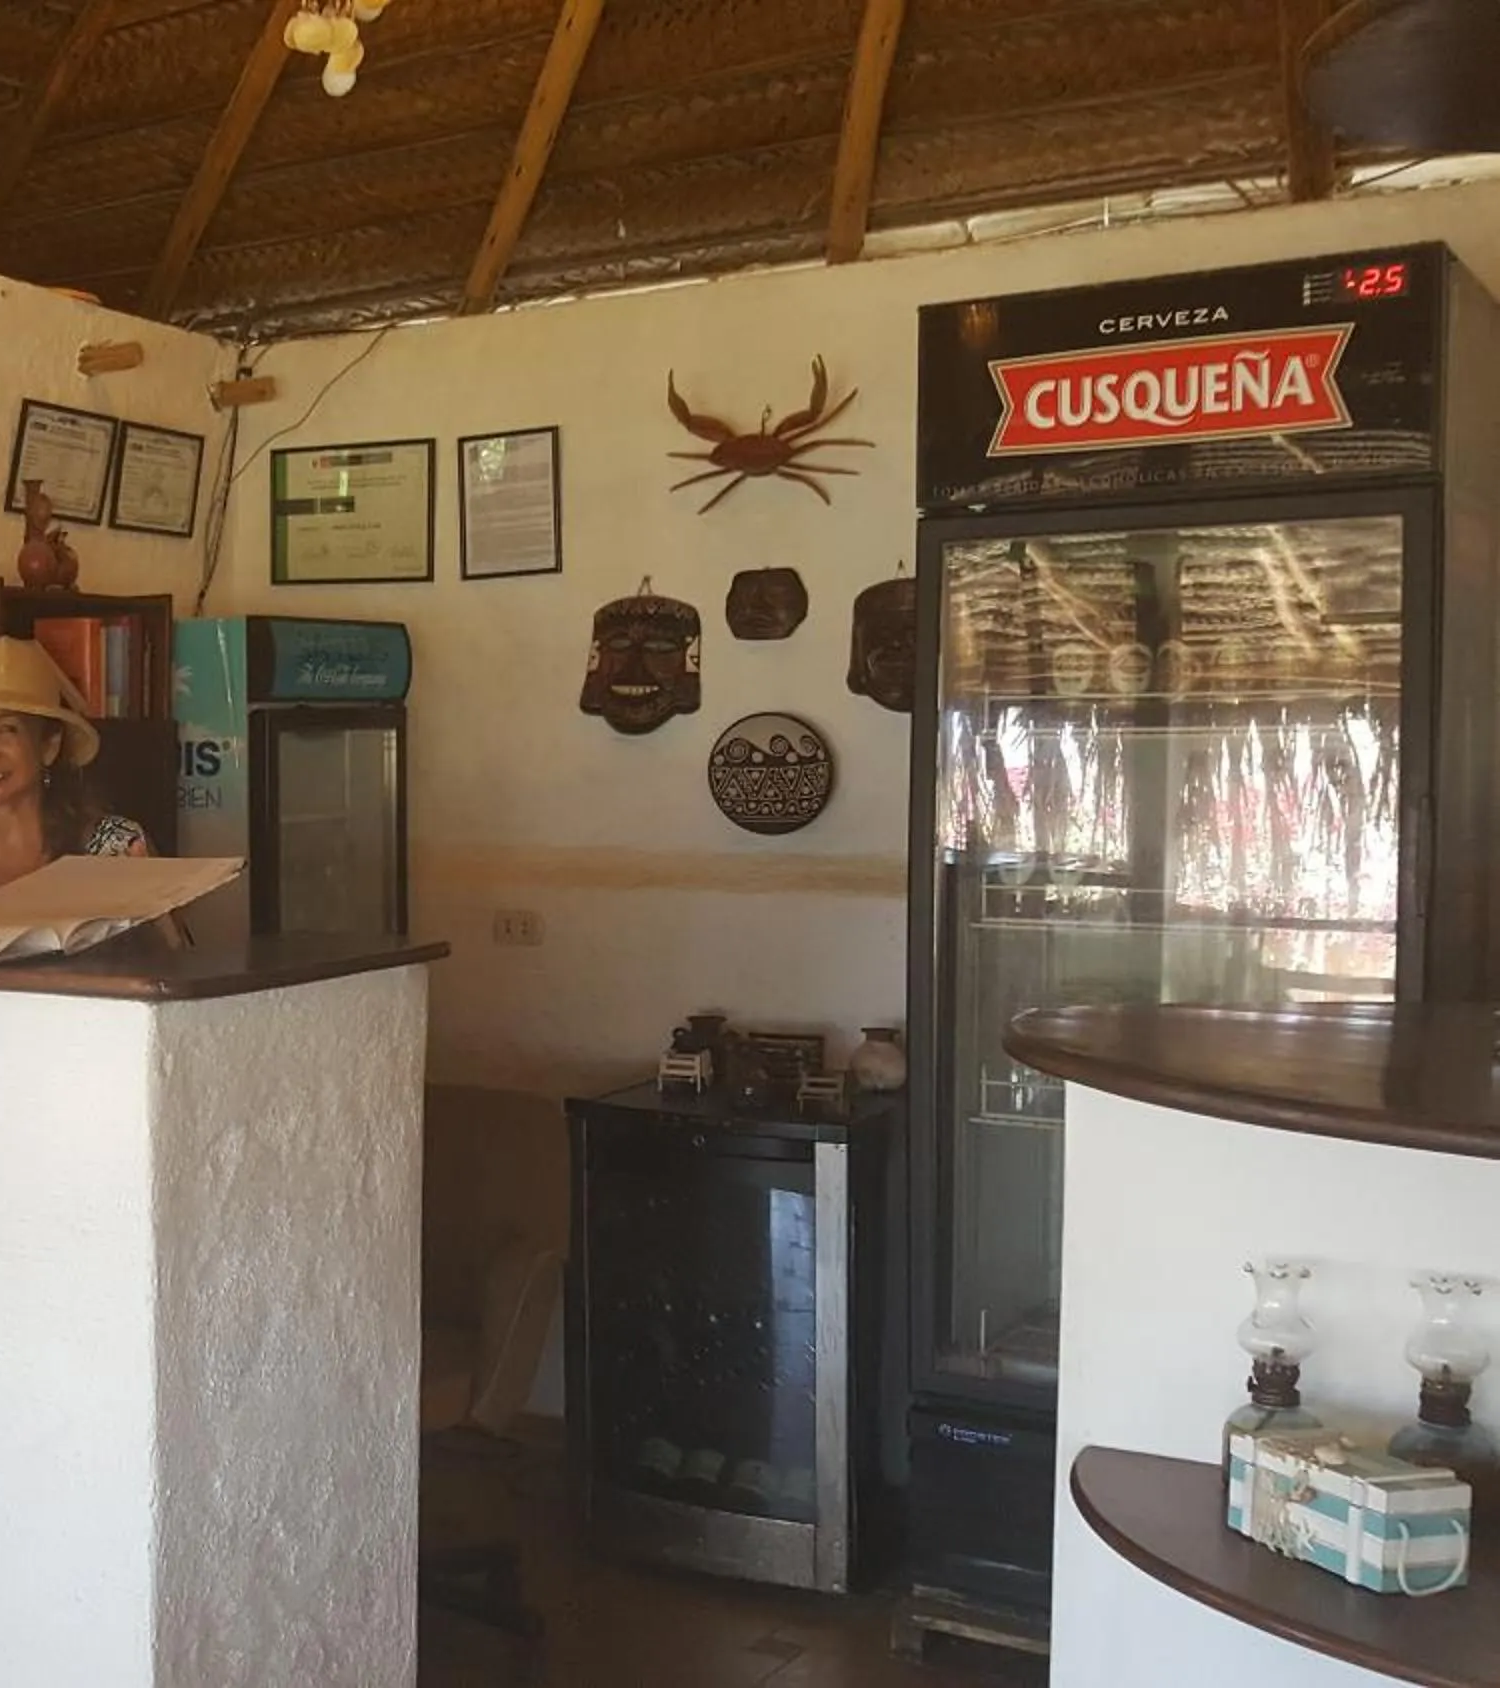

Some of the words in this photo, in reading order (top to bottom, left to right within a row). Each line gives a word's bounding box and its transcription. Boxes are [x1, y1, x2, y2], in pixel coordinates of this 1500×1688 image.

[1099, 306, 1229, 334] CERVEZA
[1024, 350, 1315, 429] CUSQUEÑA
[179, 740, 221, 777] IS
